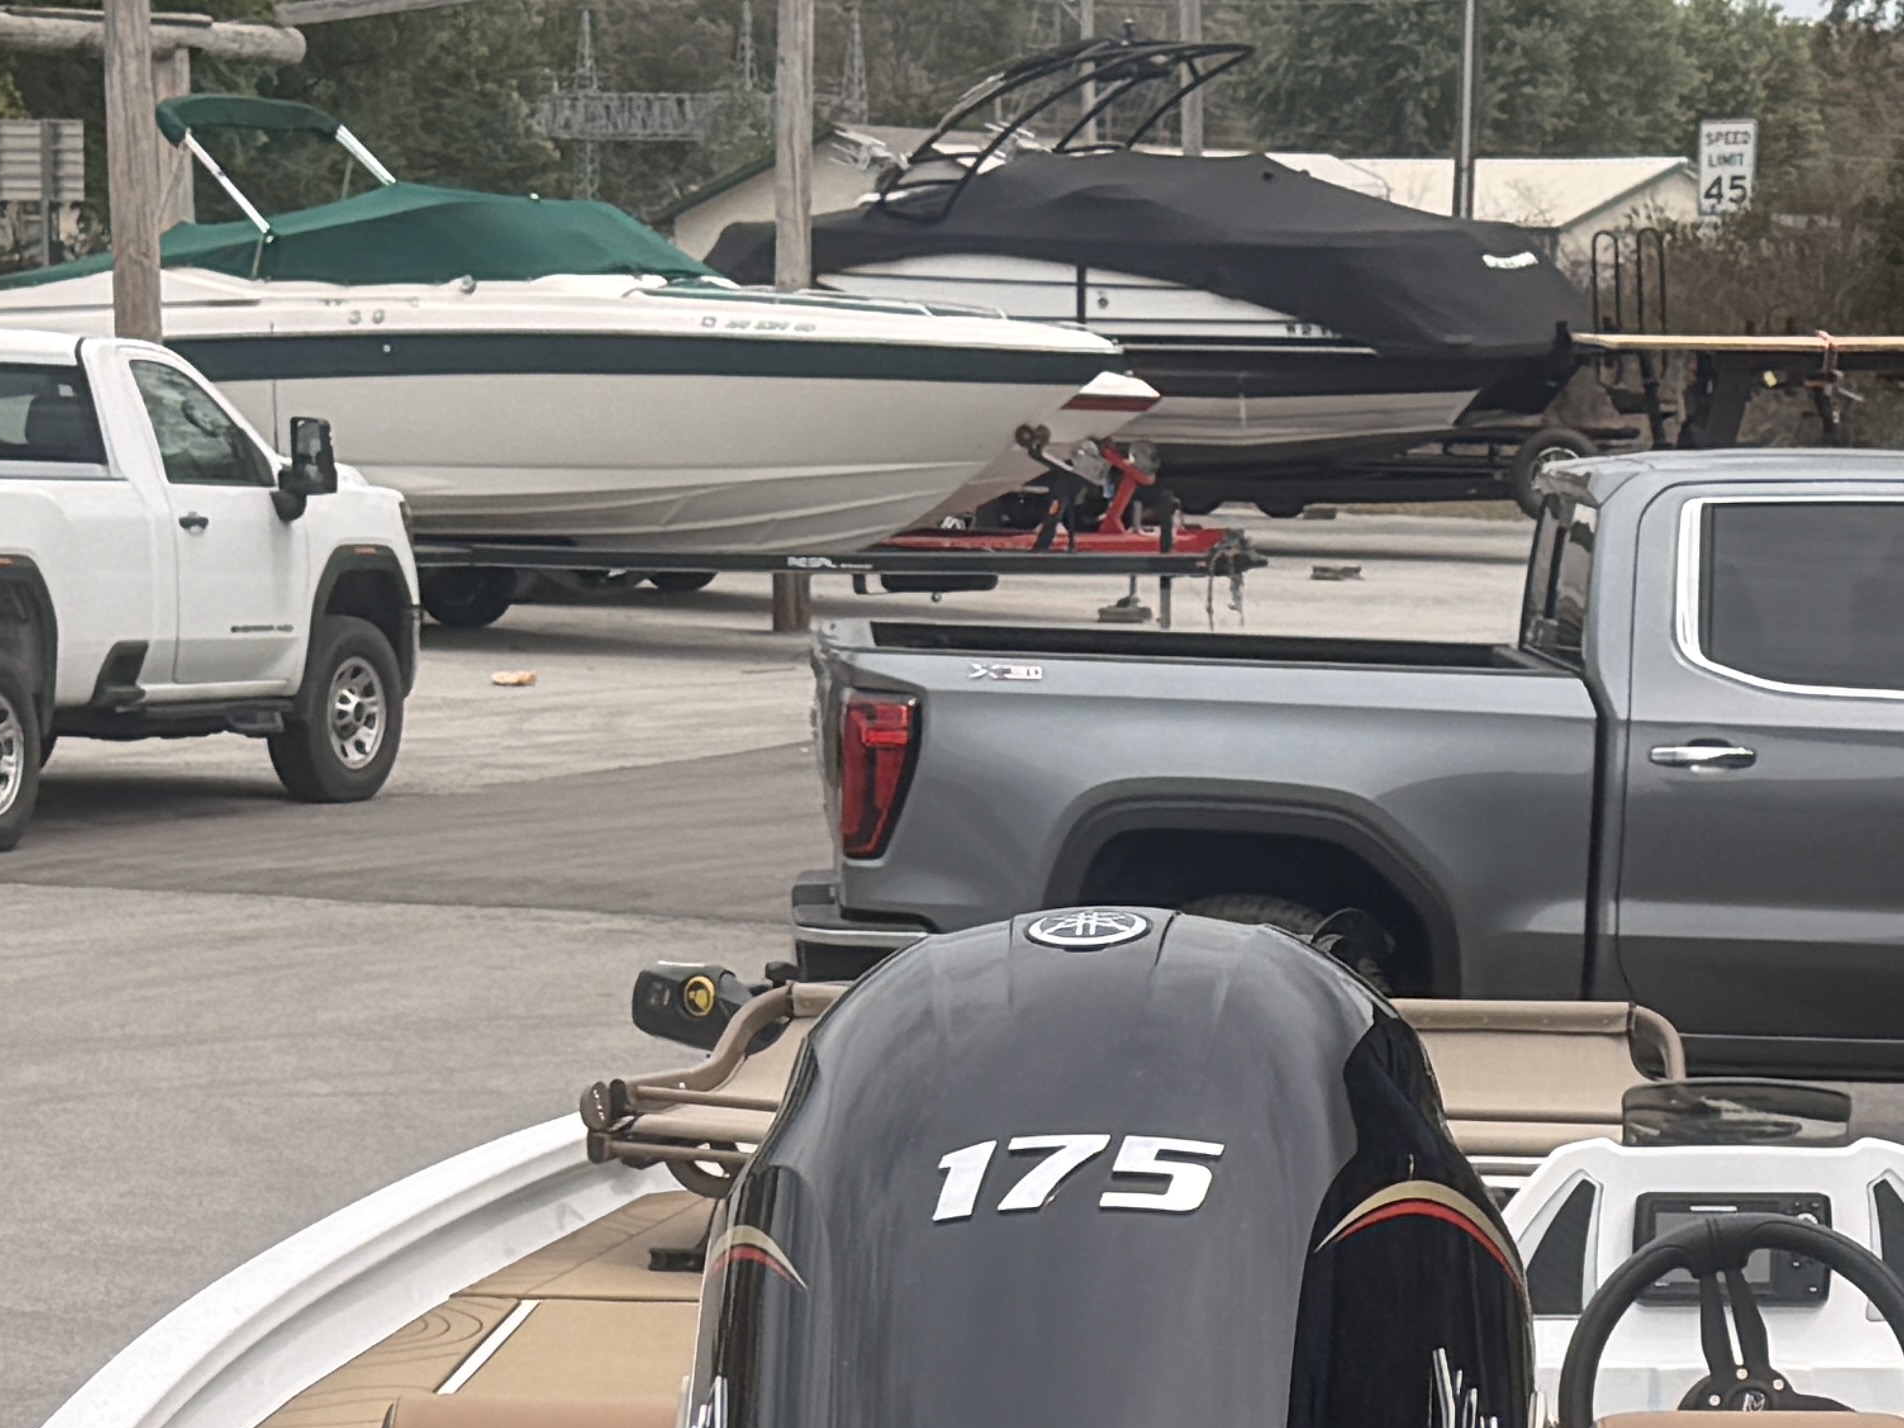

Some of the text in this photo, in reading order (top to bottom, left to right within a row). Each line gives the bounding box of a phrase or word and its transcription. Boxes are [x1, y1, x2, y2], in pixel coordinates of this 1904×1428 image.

[1705, 130, 1751, 146] SPEED
[1707, 152, 1744, 168] LIMIT
[1703, 175, 1748, 205] 45
[932, 1133, 1226, 1213] 175
